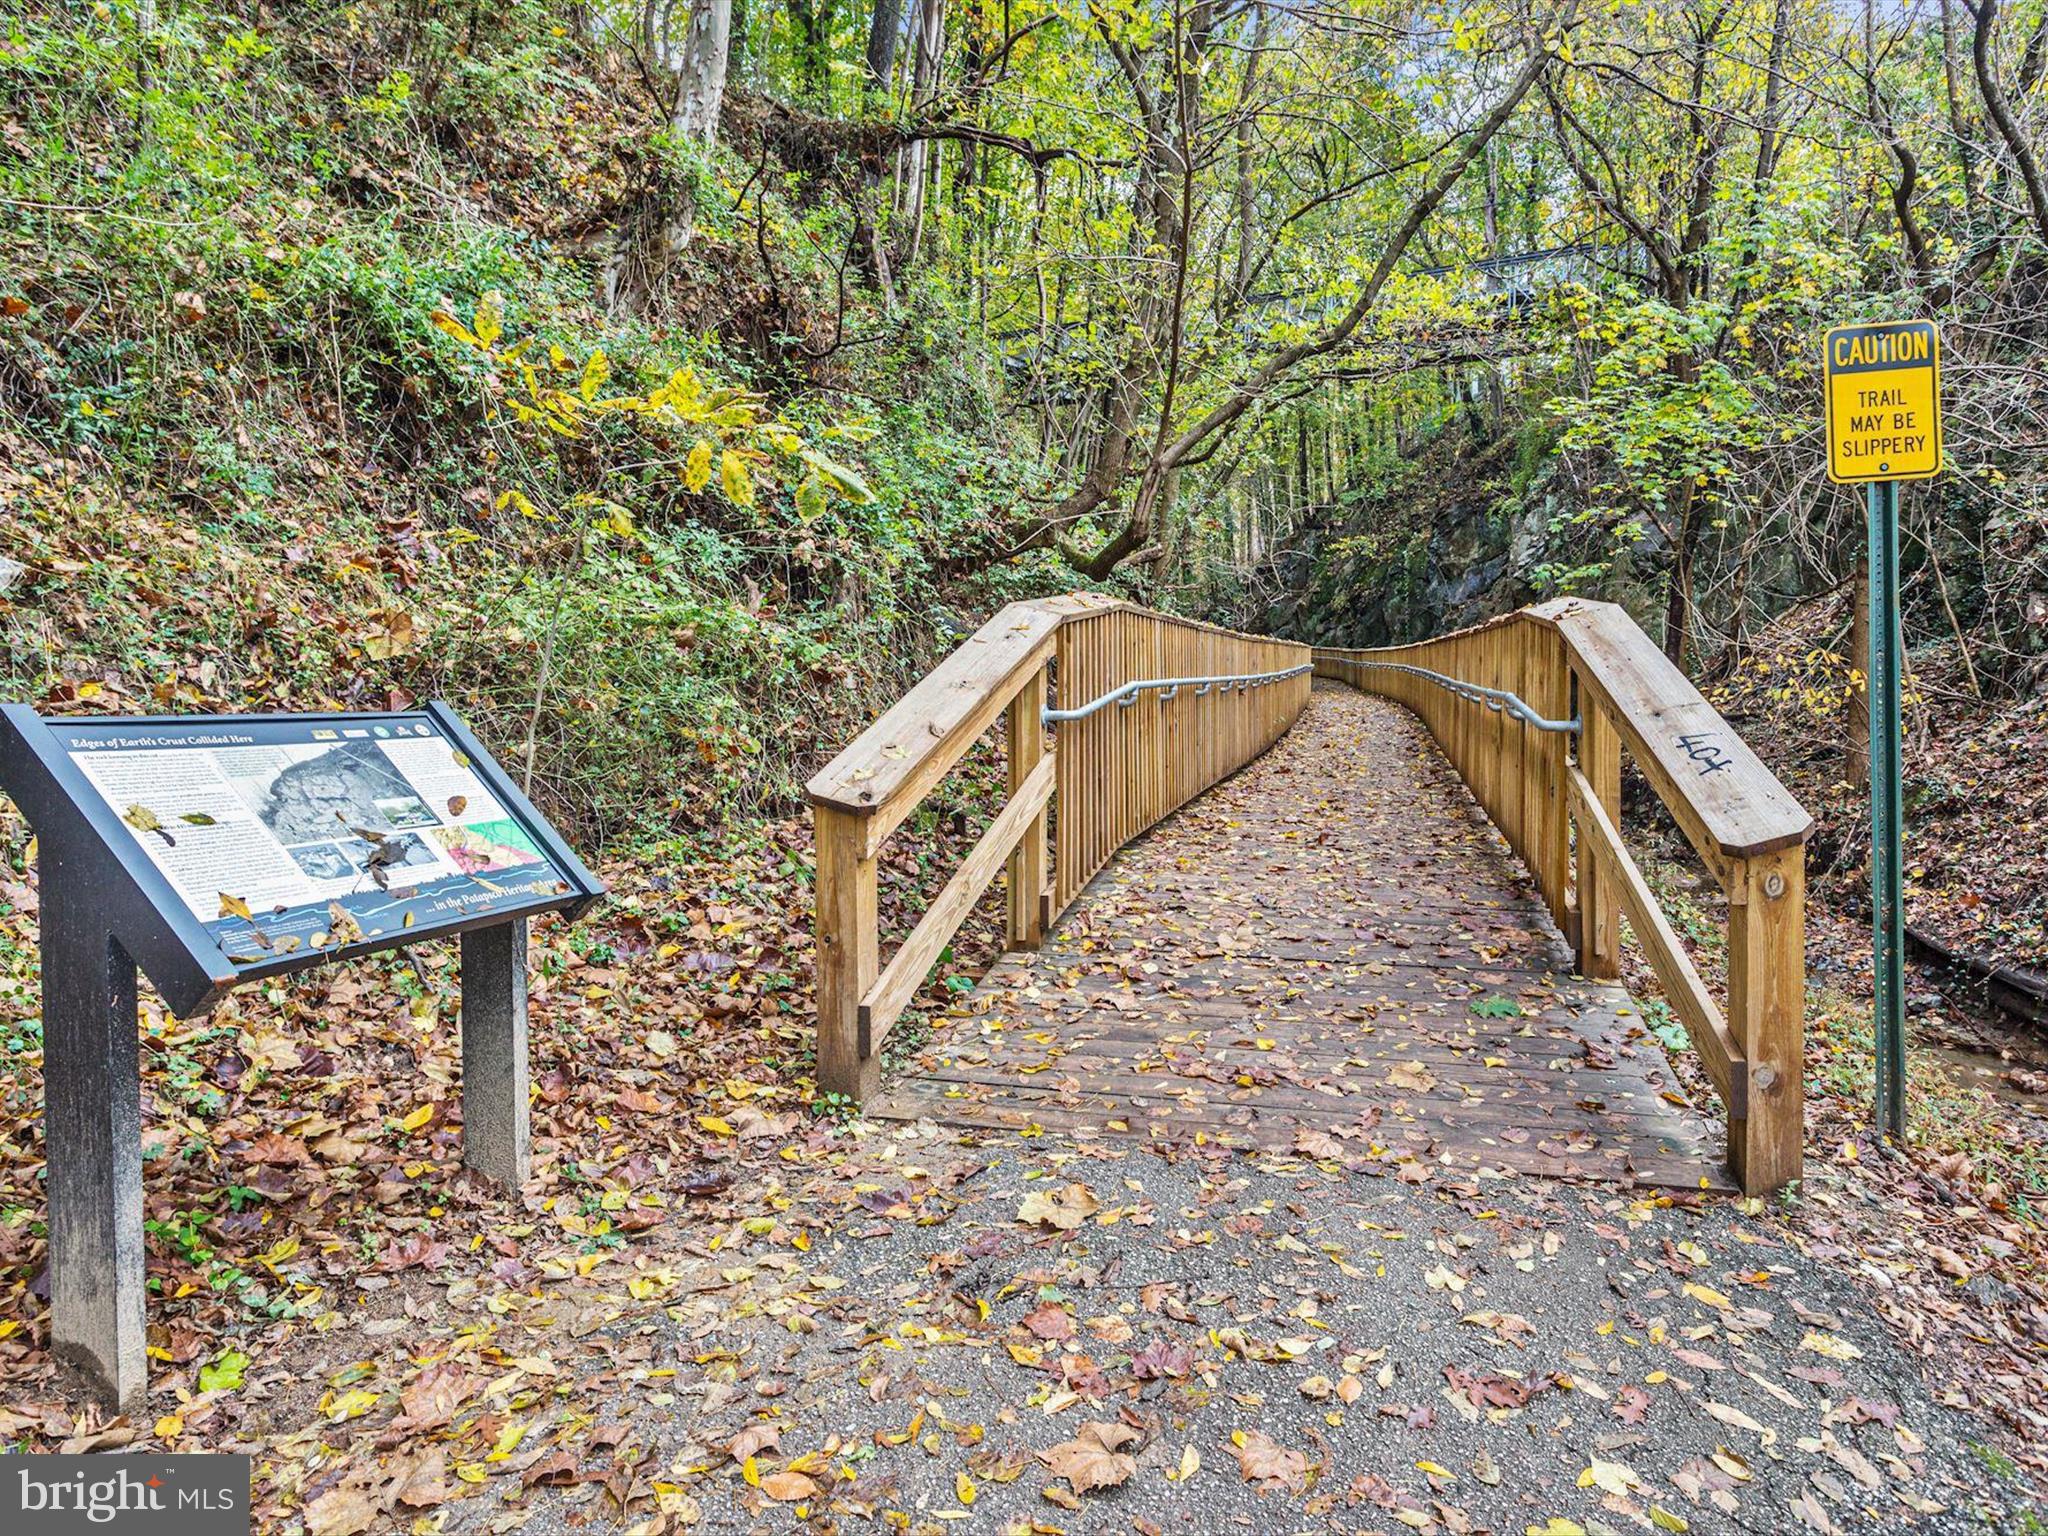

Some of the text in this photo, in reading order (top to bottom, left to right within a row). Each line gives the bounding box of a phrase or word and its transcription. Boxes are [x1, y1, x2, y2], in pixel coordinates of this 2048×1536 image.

[1835, 331, 1929, 366] CAUTION
[1858, 389, 1907, 408] TRAIL
[1851, 412, 1916, 432] MAY BE
[1842, 436, 1926, 457] SLIPPERY
[71, 735, 254, 750] Edges of Earth's Crust Collided Here
[446, 897, 464, 909] the
[502, 883, 537, 896] Heritag
